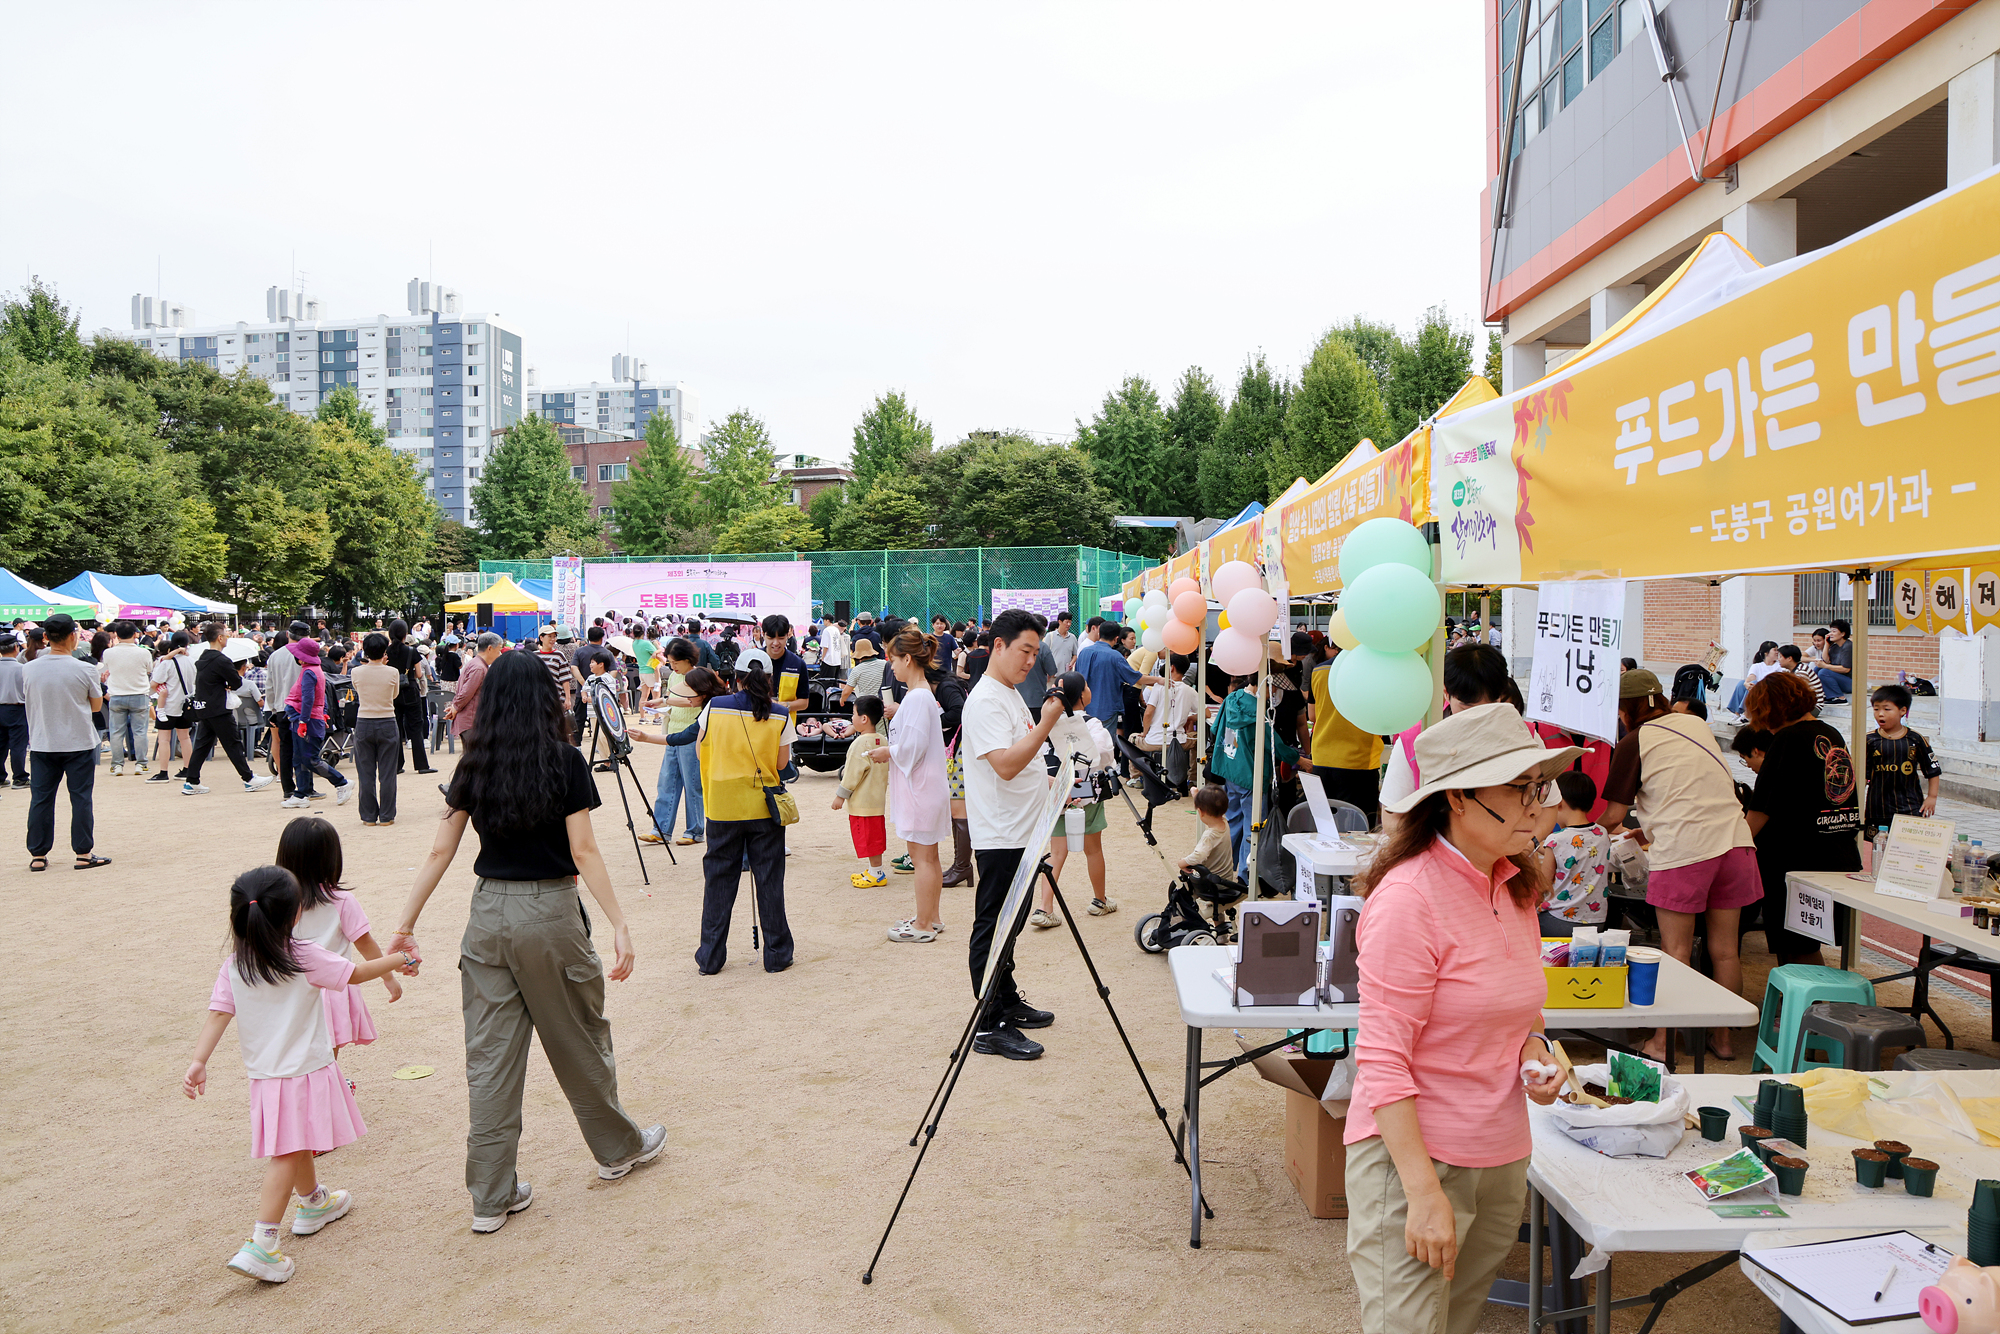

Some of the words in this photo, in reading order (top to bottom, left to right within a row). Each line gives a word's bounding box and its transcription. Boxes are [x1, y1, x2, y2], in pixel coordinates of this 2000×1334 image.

[502, 394, 513, 407] 102
[1613, 332, 1821, 485] 푸드가든
[1287, 508, 1300, 544] 일상
[1300, 505, 1307, 538] 속
[1308, 495, 1327, 536] 나만의
[1327, 487, 1341, 529] 힐링
[1342, 478, 1358, 522] 소품
[1358, 462, 1384, 515] 만들기
[1786, 469, 1932, 536] 공원여가과
[639, 593, 689, 609] 도봉1동
[1537, 611, 1584, 643] 푸드가든
[1589, 617, 1622, 650] 만들기
[1800, 911, 1823, 929] 만들기
